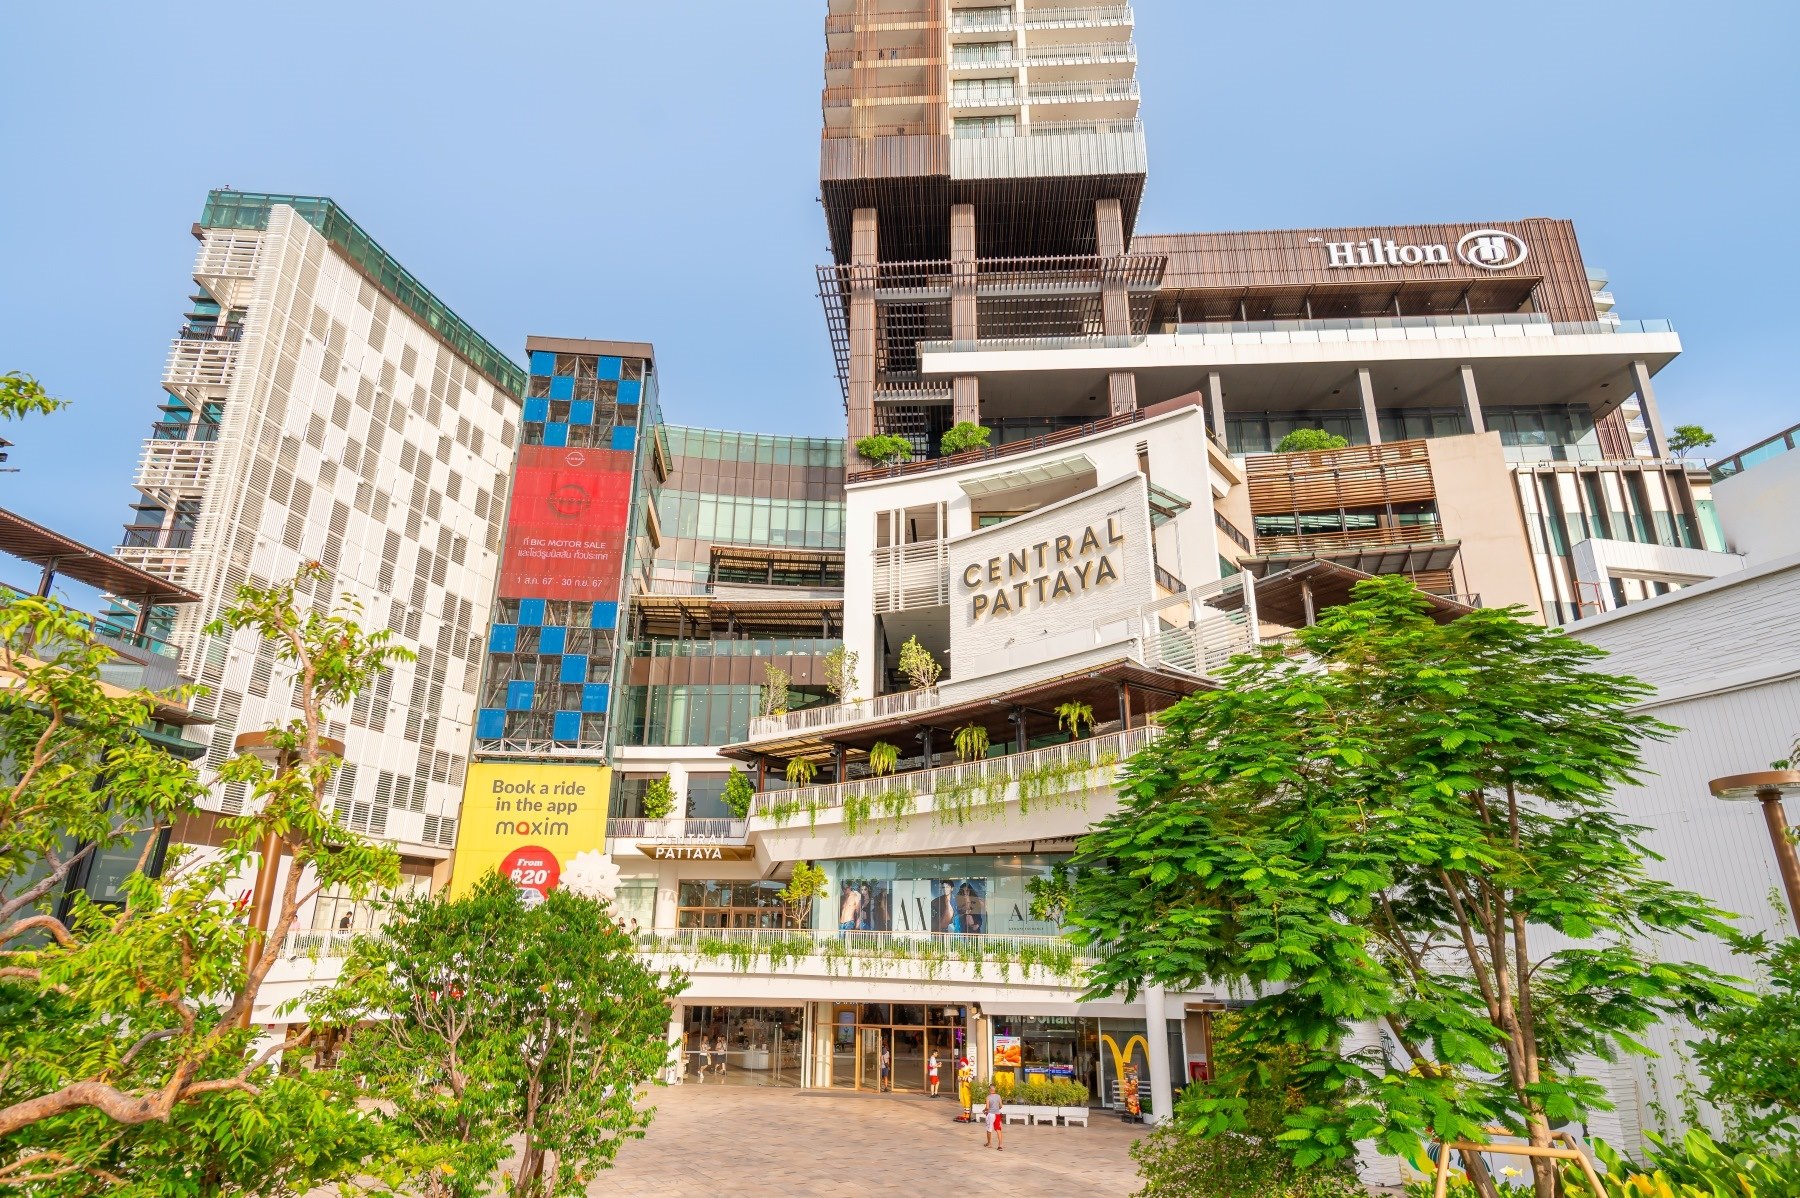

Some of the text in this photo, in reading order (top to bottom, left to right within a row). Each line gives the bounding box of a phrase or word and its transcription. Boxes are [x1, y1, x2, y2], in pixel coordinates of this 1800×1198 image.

[1326, 237, 1451, 268] Hilton
[530, 538, 546, 547] BIG
[547, 540, 582, 548] MOTOR
[583, 541, 606, 549] SALE
[963, 517, 1124, 588] CENTRAL
[542, 577, 553, 585] 67
[561, 578, 572, 586] 30
[592, 579, 603, 587] 67
[972, 555, 1118, 620] PATTAYA
[492, 779, 586, 796] Book a ride
[495, 797, 578, 815] in the app
[495, 817, 569, 836] maxim
[655, 847, 722, 859] PATTAYA
[517, 858, 544, 867] From
[1005, 1014, 1087, 1025] McDonalds
